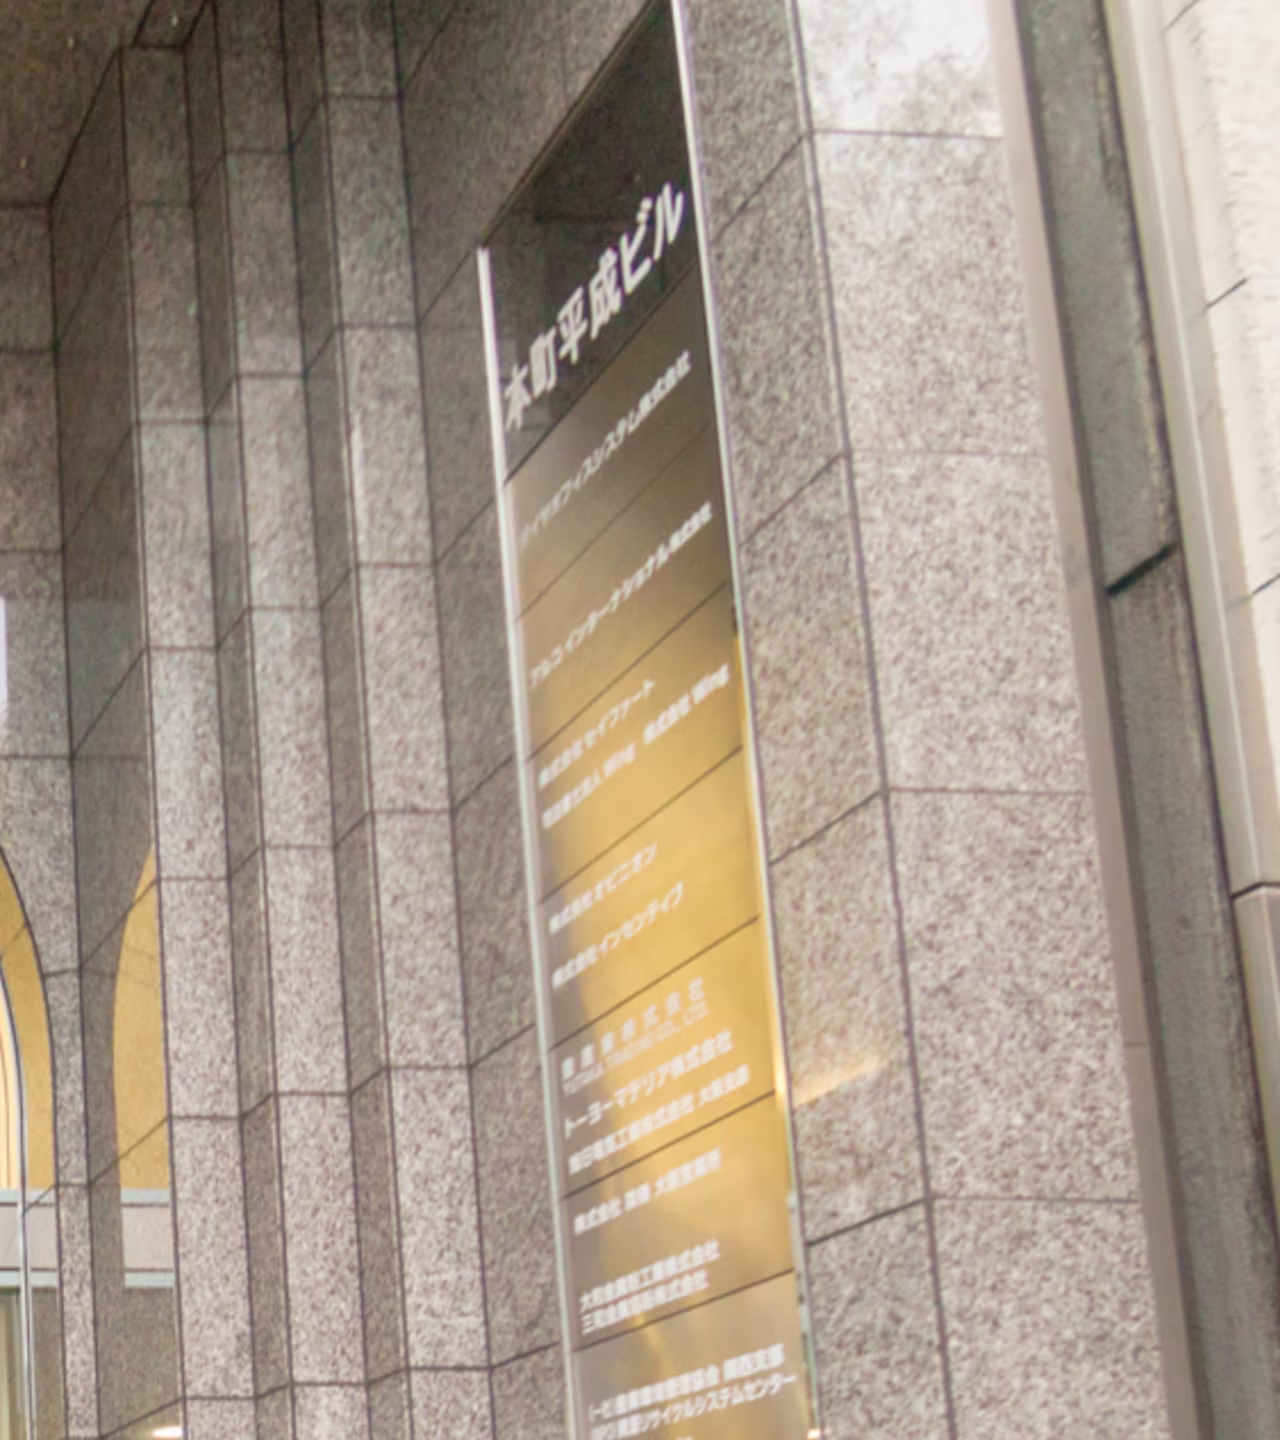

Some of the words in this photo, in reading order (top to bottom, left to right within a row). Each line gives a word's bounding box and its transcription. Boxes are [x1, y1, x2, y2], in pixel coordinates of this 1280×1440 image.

[504, 183, 684, 431] 本町平成ビル
[565, 1028, 731, 1140] トーヨーマテリア株式会社
